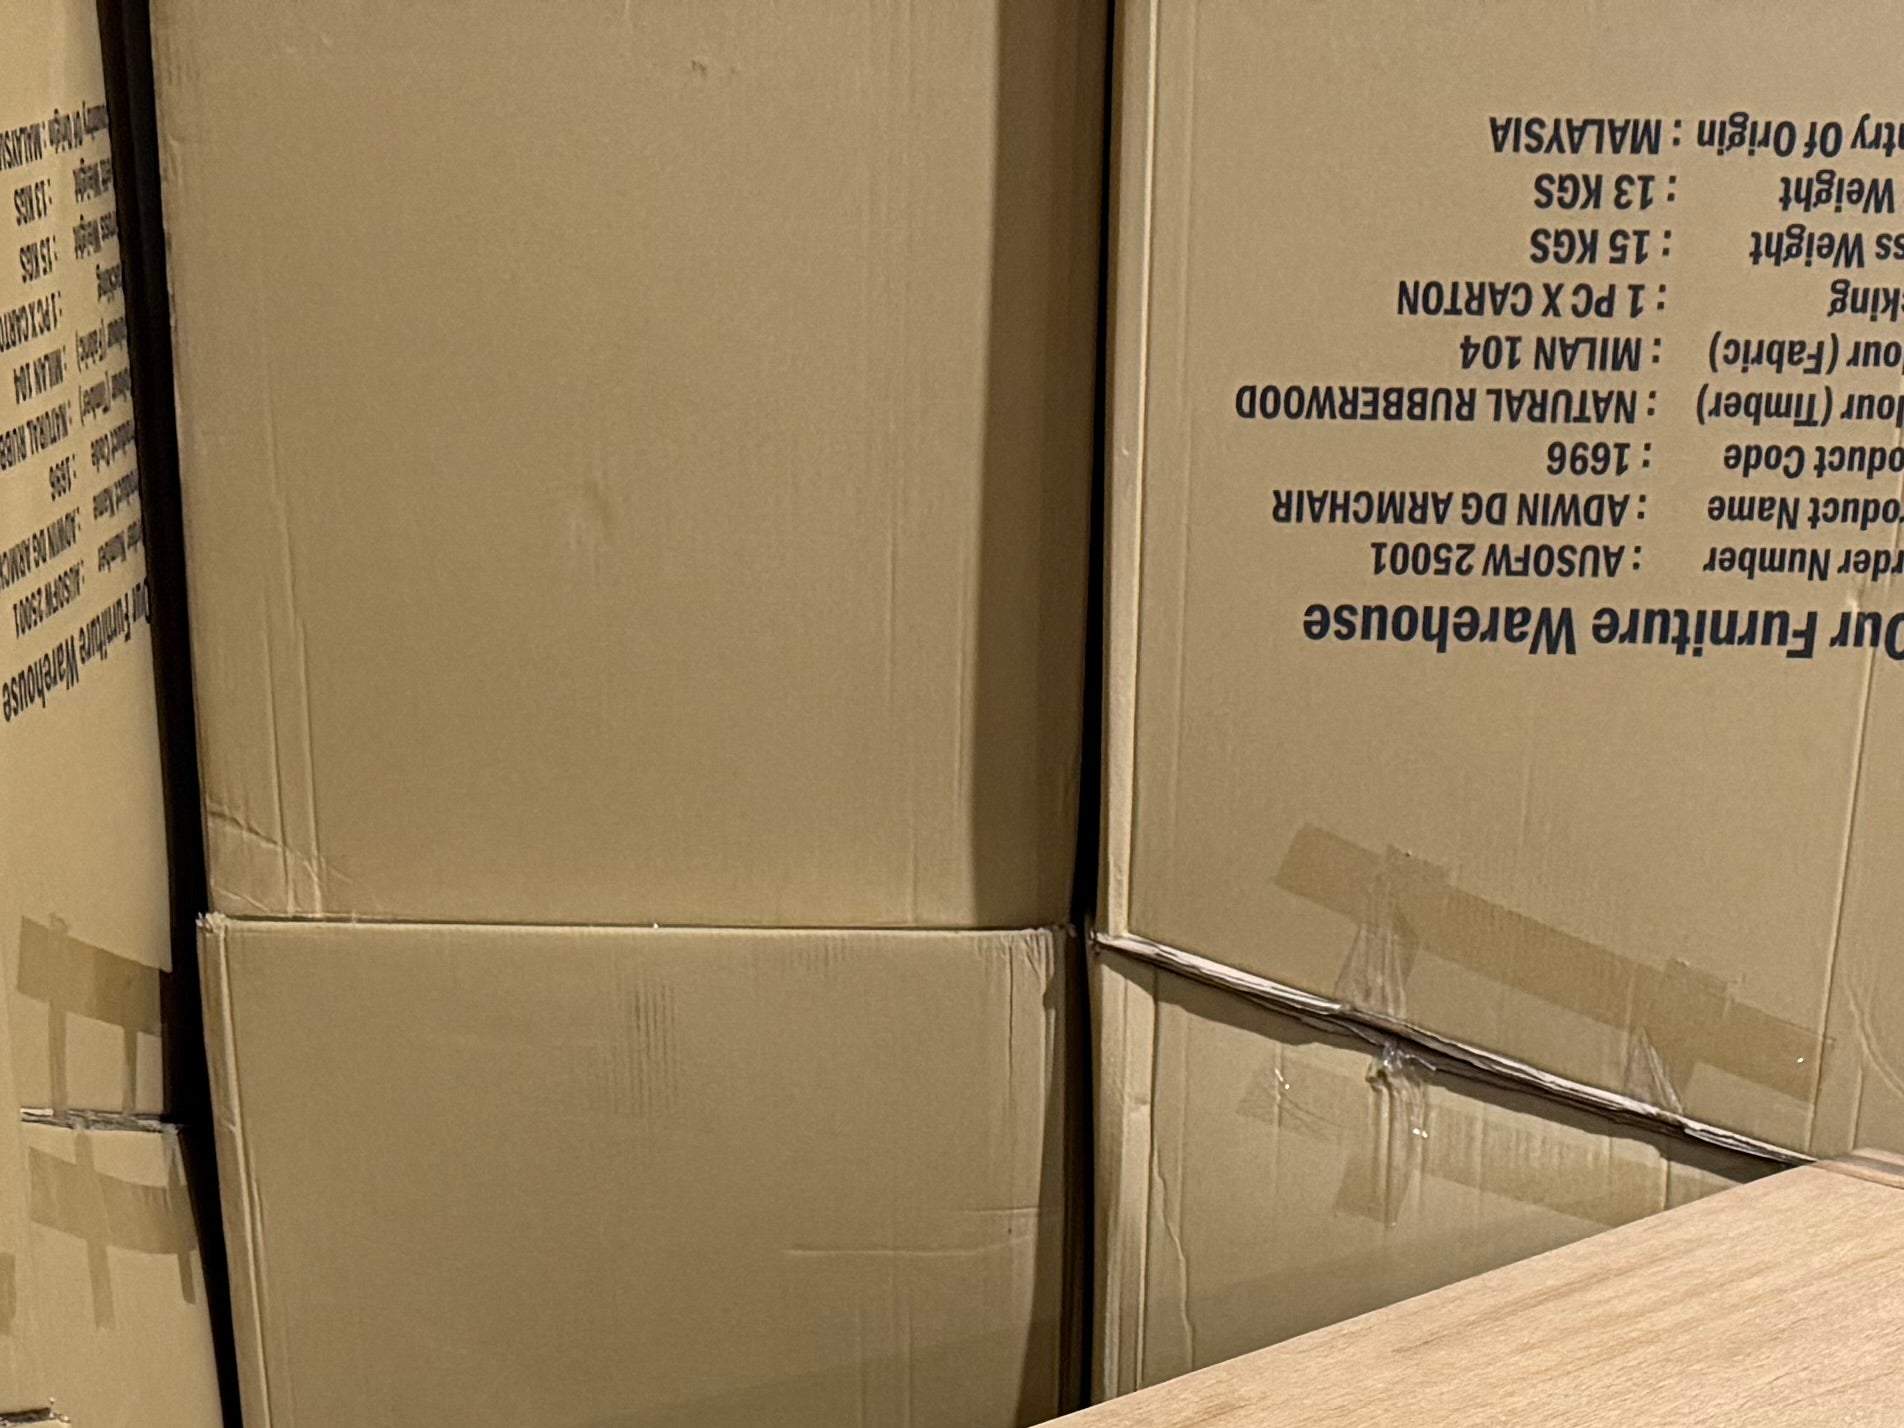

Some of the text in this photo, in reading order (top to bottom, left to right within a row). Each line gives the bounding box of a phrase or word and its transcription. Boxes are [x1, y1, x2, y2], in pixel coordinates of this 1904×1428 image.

[1490, 117, 1661, 154] MALAYSIA
[1697, 112, 1796, 157] Origin
[1803, 122, 1842, 158] Of
[1534, 174, 1602, 209] KGS
[1614, 174, 1655, 210] 13
[1779, 169, 1894, 213] Weight
[1530, 228, 1598, 264] KGS
[1609, 229, 1650, 264] 15
[1749, 224, 1864, 268] Weight
[1398, 280, 1532, 317] CARTON
[1541, 283, 1564, 317] X
[1571, 283, 1616, 318] PC
[1628, 284, 1645, 318] 1
[1460, 335, 1522, 370] 104
[1534, 337, 1641, 371] MILAN
[1709, 331, 1838, 375] (Fabric)
[1236, 385, 1476, 421] RUBBERWOOD
[1486, 389, 1636, 424] NATURAL
[1697, 384, 1832, 427] (Timber)
[1547, 441, 1630, 476] 1696
[1724, 444, 1805, 479] Code
[1273, 490, 1453, 524] ARMCHAIR
[1462, 492, 1507, 525] DG
[1517, 493, 1630, 527] ADWIN
[1708, 496, 1800, 529] Name
[1371, 542, 1475, 576] 25001
[1482, 544, 1625, 577] AUSOFW
[1703, 547, 1830, 581] Number
[1303, 604, 1576, 655] Warehouse
[1592, 608, 1817, 658] Furniture
[3, 635, 79, 722] Warehouse
